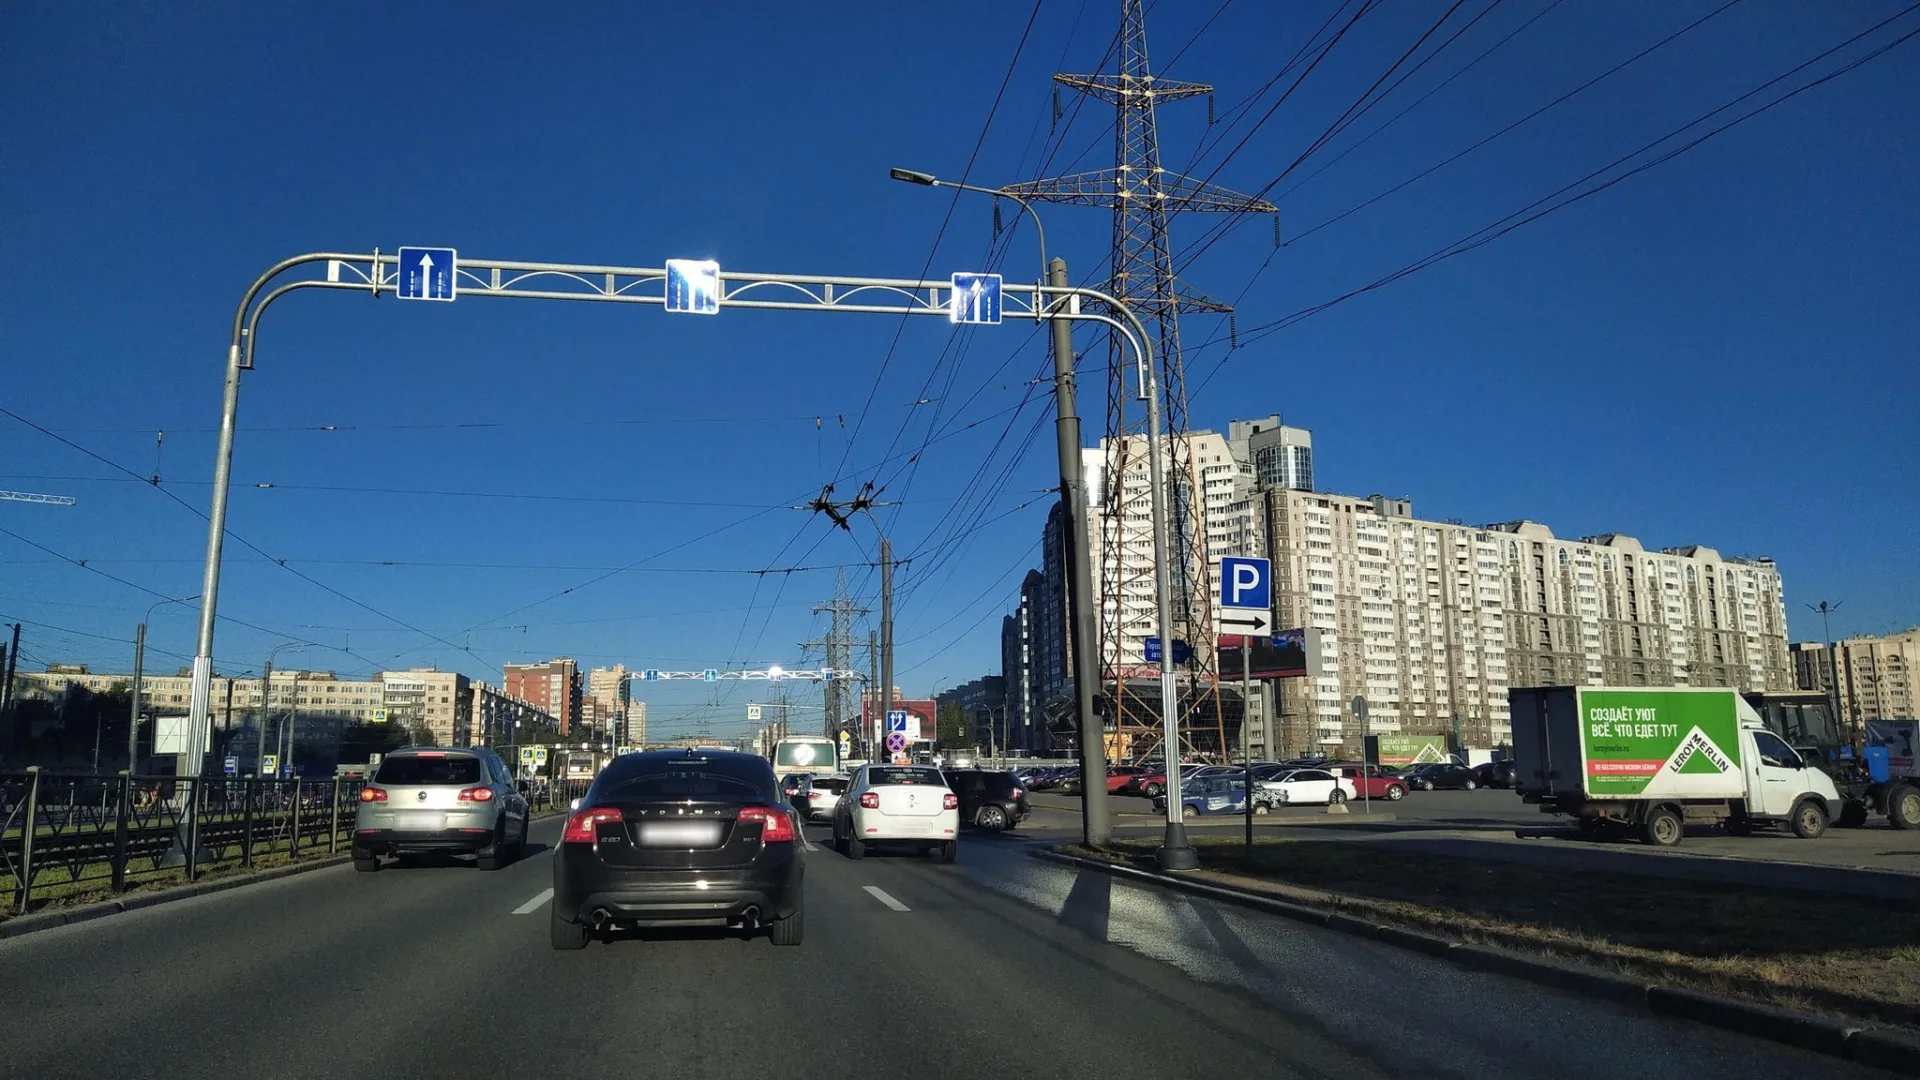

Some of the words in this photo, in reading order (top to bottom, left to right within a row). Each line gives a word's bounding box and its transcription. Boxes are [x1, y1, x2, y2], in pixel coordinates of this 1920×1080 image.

[1233, 563, 1260, 603] P
[1590, 706, 1633, 722] СОЗДАЁТ
[1634, 708, 1656, 721] УЮТ
[1591, 722, 1613, 737] ВСЁ,
[1614, 724, 1633, 737] ЧТО
[1634, 724, 1659, 739] ЕДЕТ
[1660, 724, 1678, 737] ТУТ
[1669, 740, 1695, 773] LEROY
[1691, 733, 1729, 772] MERLIN
[640, 808, 721, 816] VOLVO
